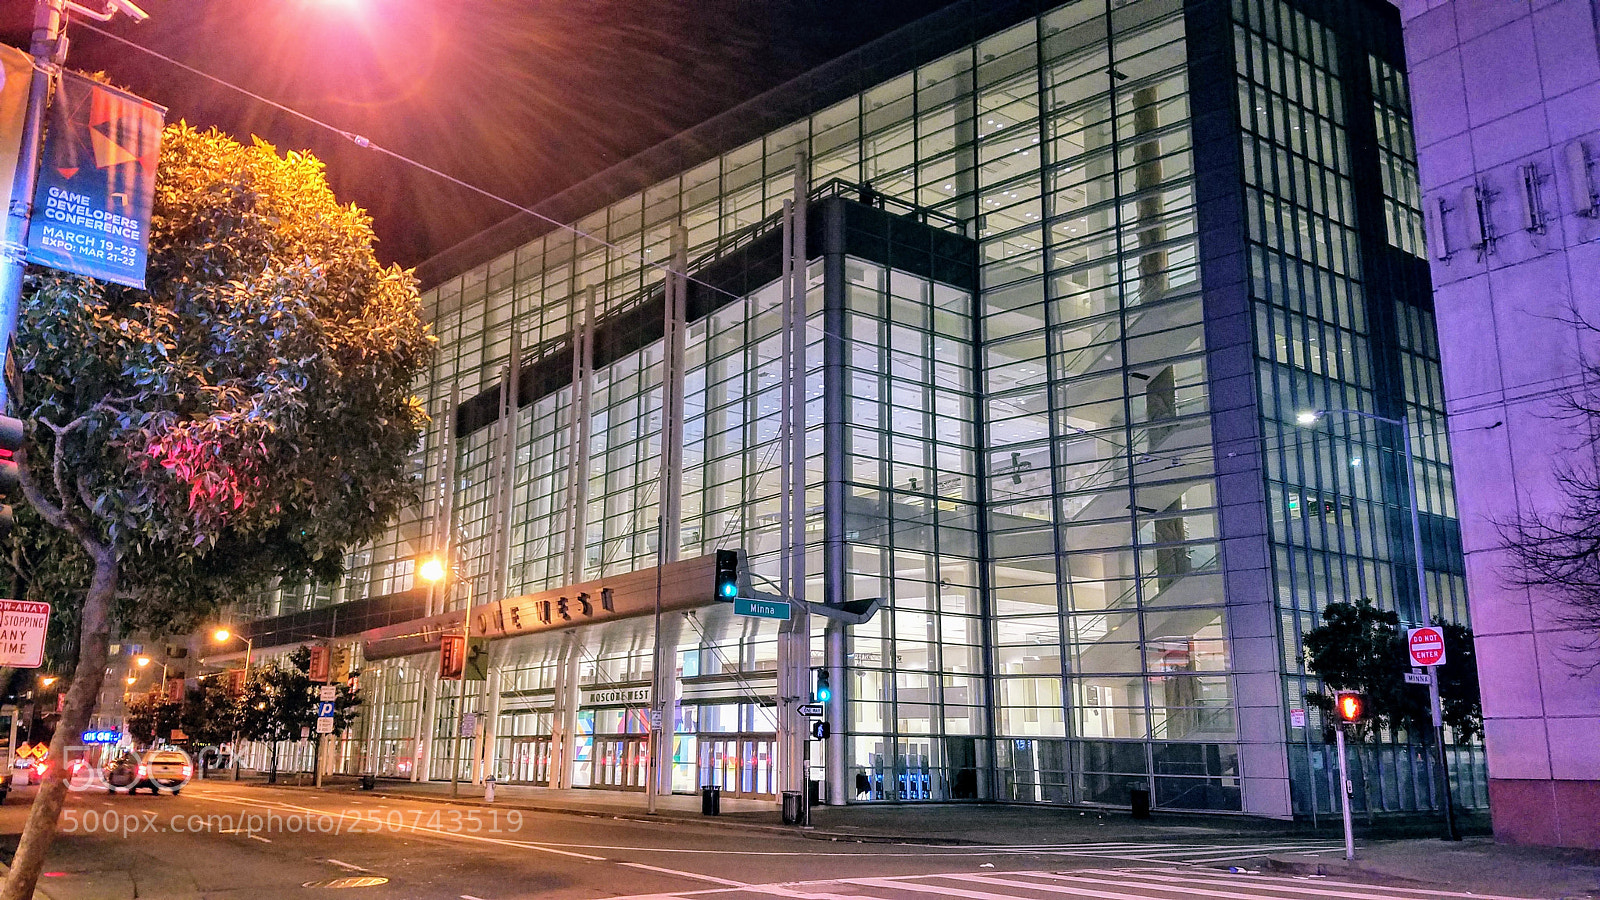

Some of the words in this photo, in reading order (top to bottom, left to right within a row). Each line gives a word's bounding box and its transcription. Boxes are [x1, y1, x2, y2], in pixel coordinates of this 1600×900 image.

[48, 186, 90, 206] GAME
[46, 197, 138, 230] DEVELOPERS
[44, 208, 140, 241] CONFERENCE
[42, 236, 76, 252] EXPO:
[79, 246, 104, 259] MAR
[106, 253, 135, 267] 21-23
[43, 226, 95, 246] MARCH
[100, 239, 137, 257] 19-23
[536, 587, 616, 626] WEST
[750, 603, 775, 615] Minna
[4, 615, 44, 628] STOPPING
[0, 629, 26, 641] ANY
[590, 691, 626, 703] MOSCONE
[627, 689, 649, 701] WEST
[320, 703, 333, 717] P
